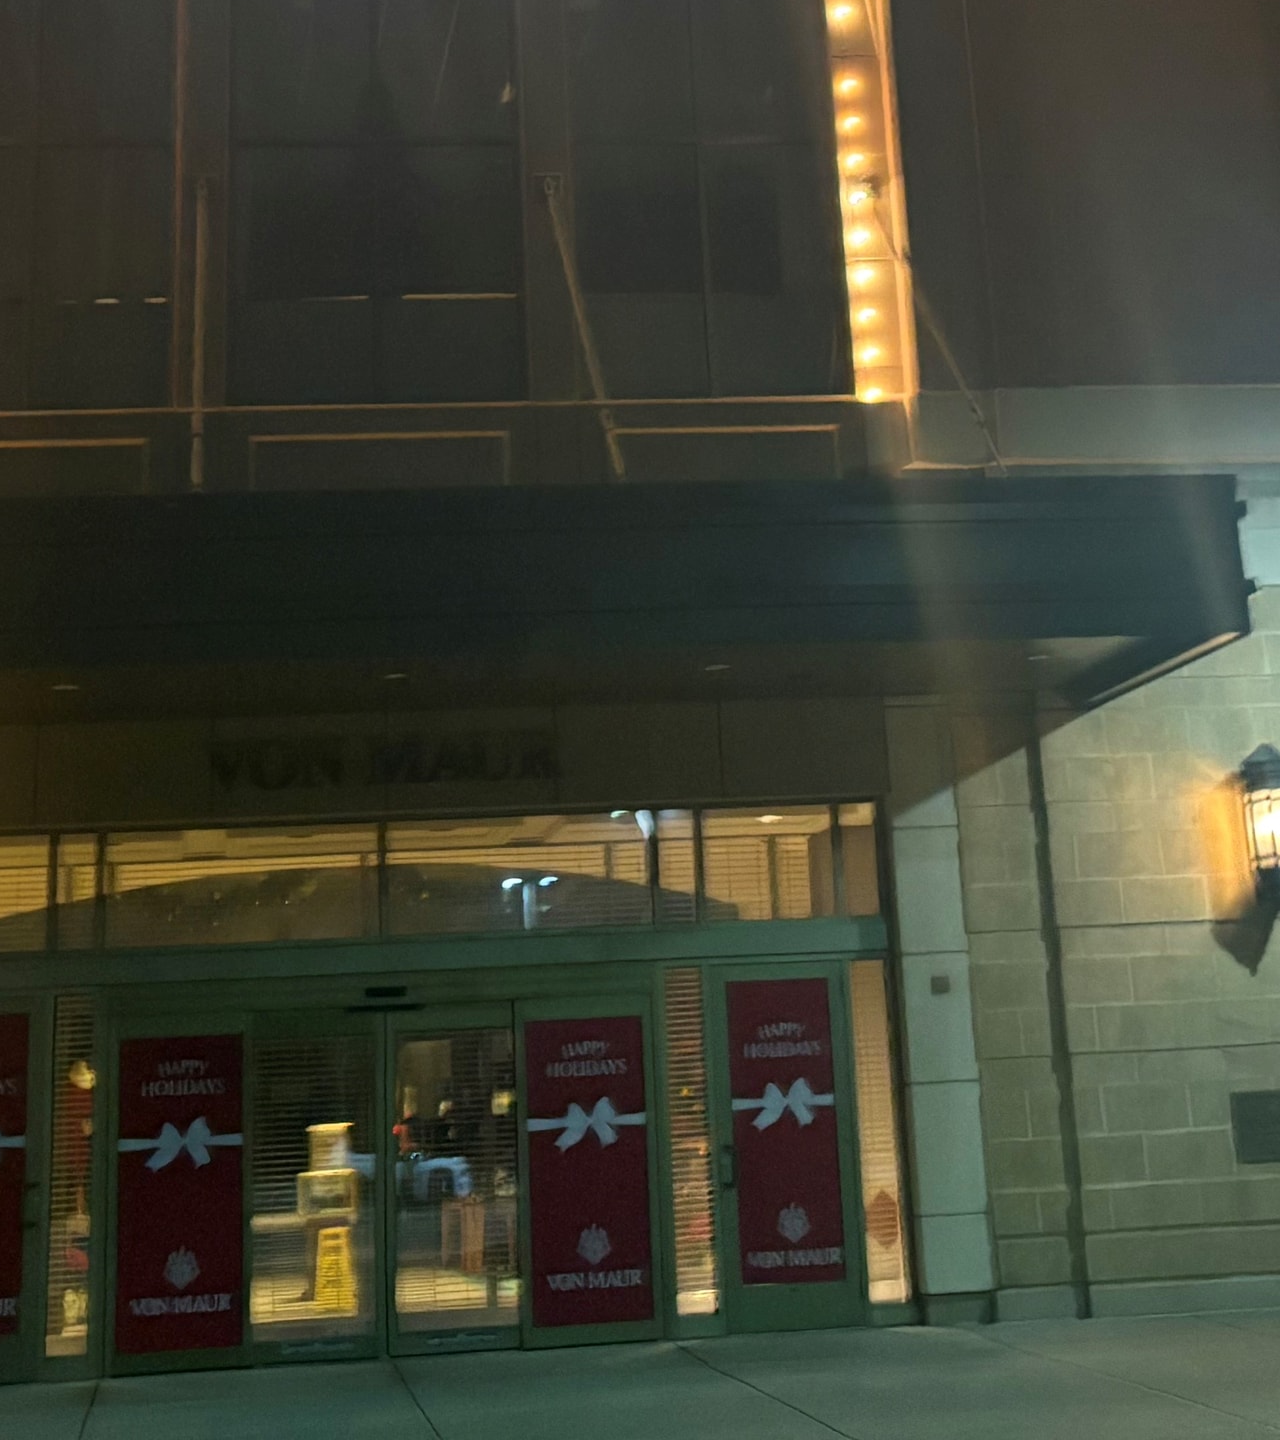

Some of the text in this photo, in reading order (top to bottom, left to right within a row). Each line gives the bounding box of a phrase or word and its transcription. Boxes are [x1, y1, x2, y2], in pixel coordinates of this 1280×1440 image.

[207, 738, 346, 791] VON
[758, 1022, 806, 1040] HAPPY
[562, 1040, 610, 1059] HAPPY
[158, 1059, 210, 1078] HAPPY
[546, 1058, 627, 1078] HOLIDAYS
[141, 1078, 226, 1097] HOLIDAYS
[747, 1247, 843, 1269] VON MAUR
[547, 1268, 643, 1292] VON MAUR
[130, 1293, 233, 1317] VON MAUR
